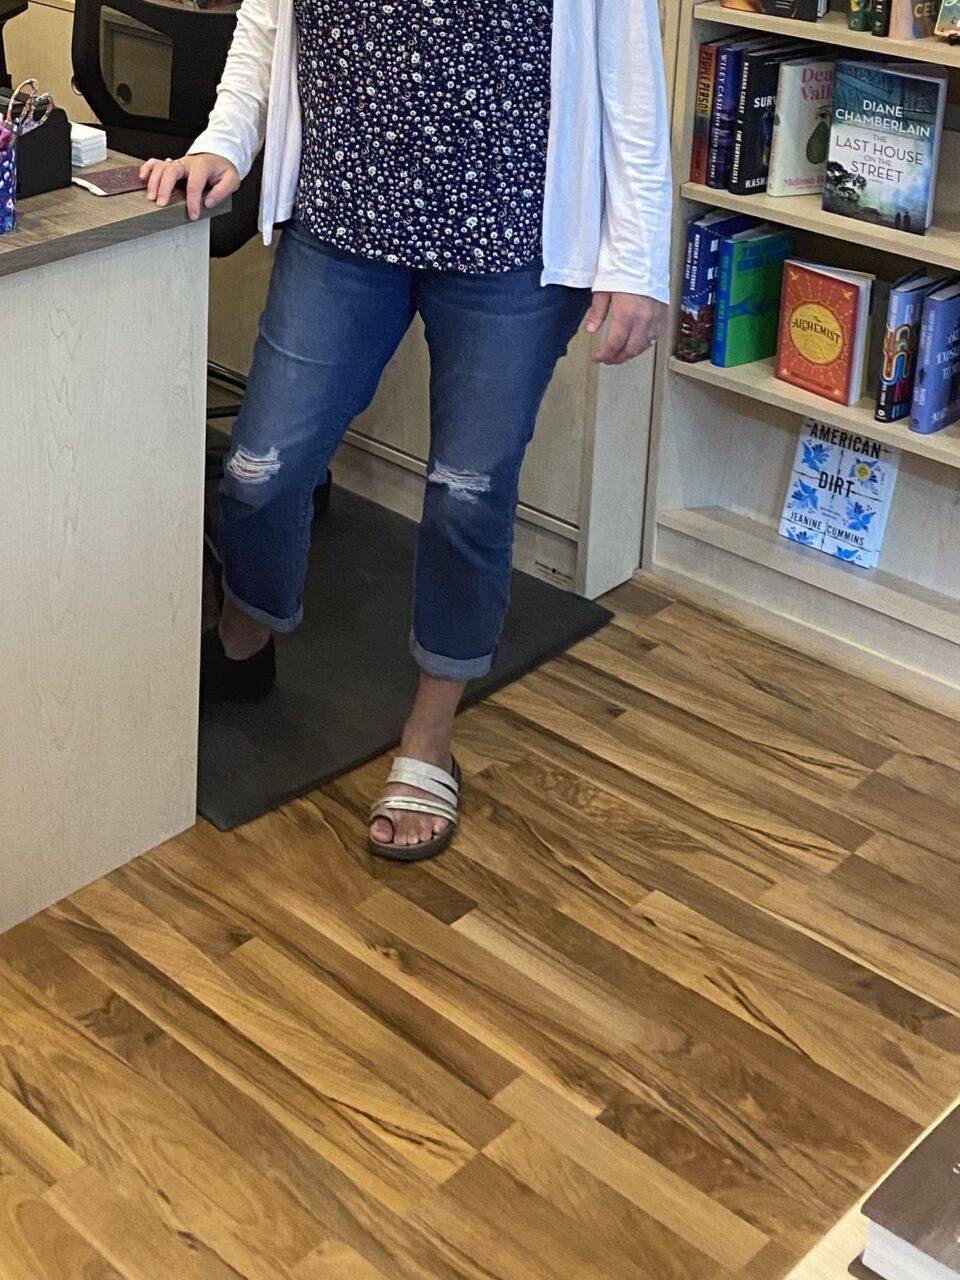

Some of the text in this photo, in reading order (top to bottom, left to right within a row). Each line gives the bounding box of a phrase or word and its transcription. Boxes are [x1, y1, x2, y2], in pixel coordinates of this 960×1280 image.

[719, 53, 727, 83] WILEY
[697, 82, 711, 116] PERSON
[716, 84, 724, 111] CASH
[862, 100, 904, 117] DIANE
[835, 108, 931, 137] CHAMBERLAIN
[836, 135, 924, 166] LAST HOUSE
[873, 134, 887, 143] THE
[851, 161, 904, 183] STREET
[864, 155, 891, 167] ON THE
[792, 317, 841, 345] ALCHEMIST
[810, 422, 882, 459] AMERICAN
[818, 471, 855, 498] DIRT
[790, 511, 865, 546] JEANINE CUMMINS
